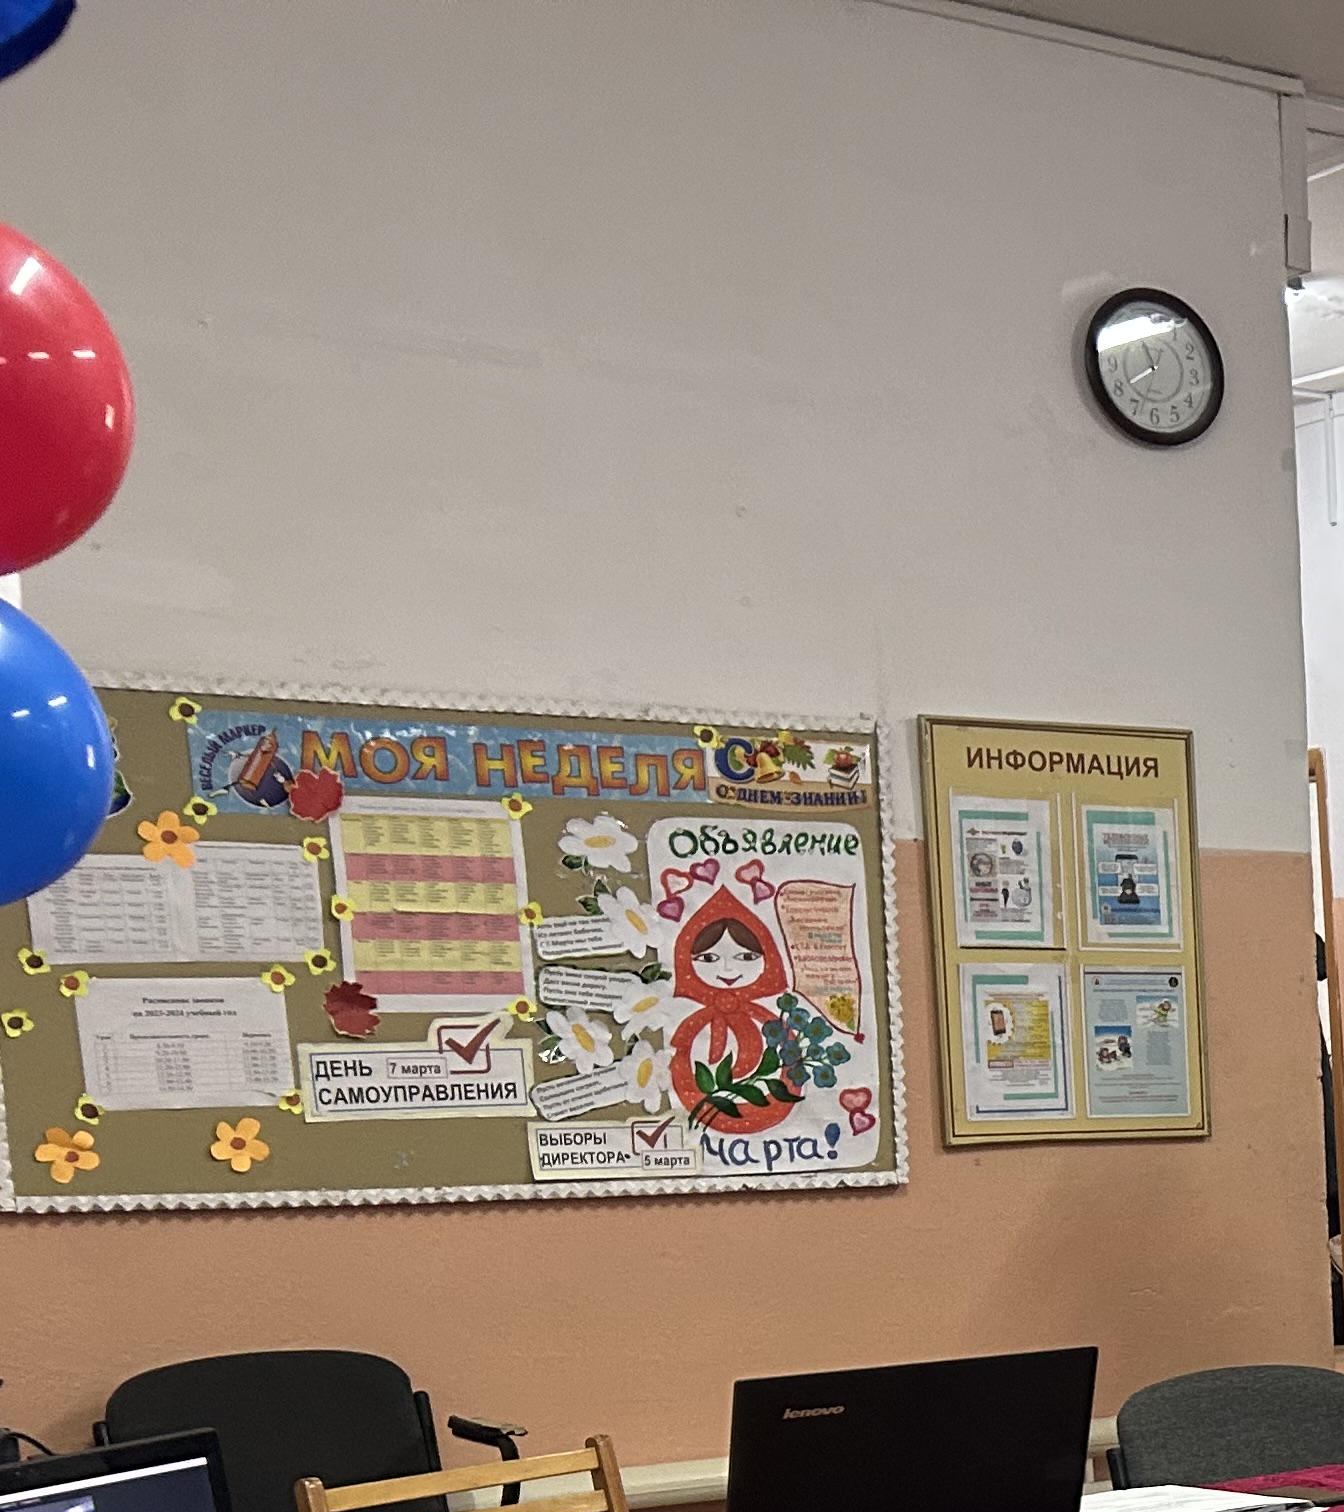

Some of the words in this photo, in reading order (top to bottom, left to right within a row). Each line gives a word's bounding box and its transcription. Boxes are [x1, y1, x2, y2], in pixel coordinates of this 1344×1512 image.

[1185, 343, 1196, 361] 2
[1189, 368, 1200, 386] 3
[1113, 380, 1124, 397] 8
[1129, 399, 1140, 416] 7
[1183, 392, 1195, 409] 4
[1150, 407, 1160, 425] 6
[1170, 405, 1181, 423] 5
[301, 730, 449, 784] МОЯ
[473, 740, 706, 797] НЕДЕЛЯ
[966, 746, 1160, 781] ИНФОРМАЦИЯ
[668, 824, 860, 859] Объявление
[315, 1059, 373, 1081] ДЕНЬ
[389, 1061, 397, 1075] 7
[401, 1064, 441, 1079] марта
[318, 1082, 518, 1106] САМОУПРАВЛЕНИЯ
[539, 1132, 607, 1147] ВЫБОРЫ
[541, 1150, 626, 1167] ДИРЕКТОРА
[644, 1154, 651, 1166] 5
[654, 1155, 691, 1169] марта
[783, 1405, 845, 1420] lenovo
